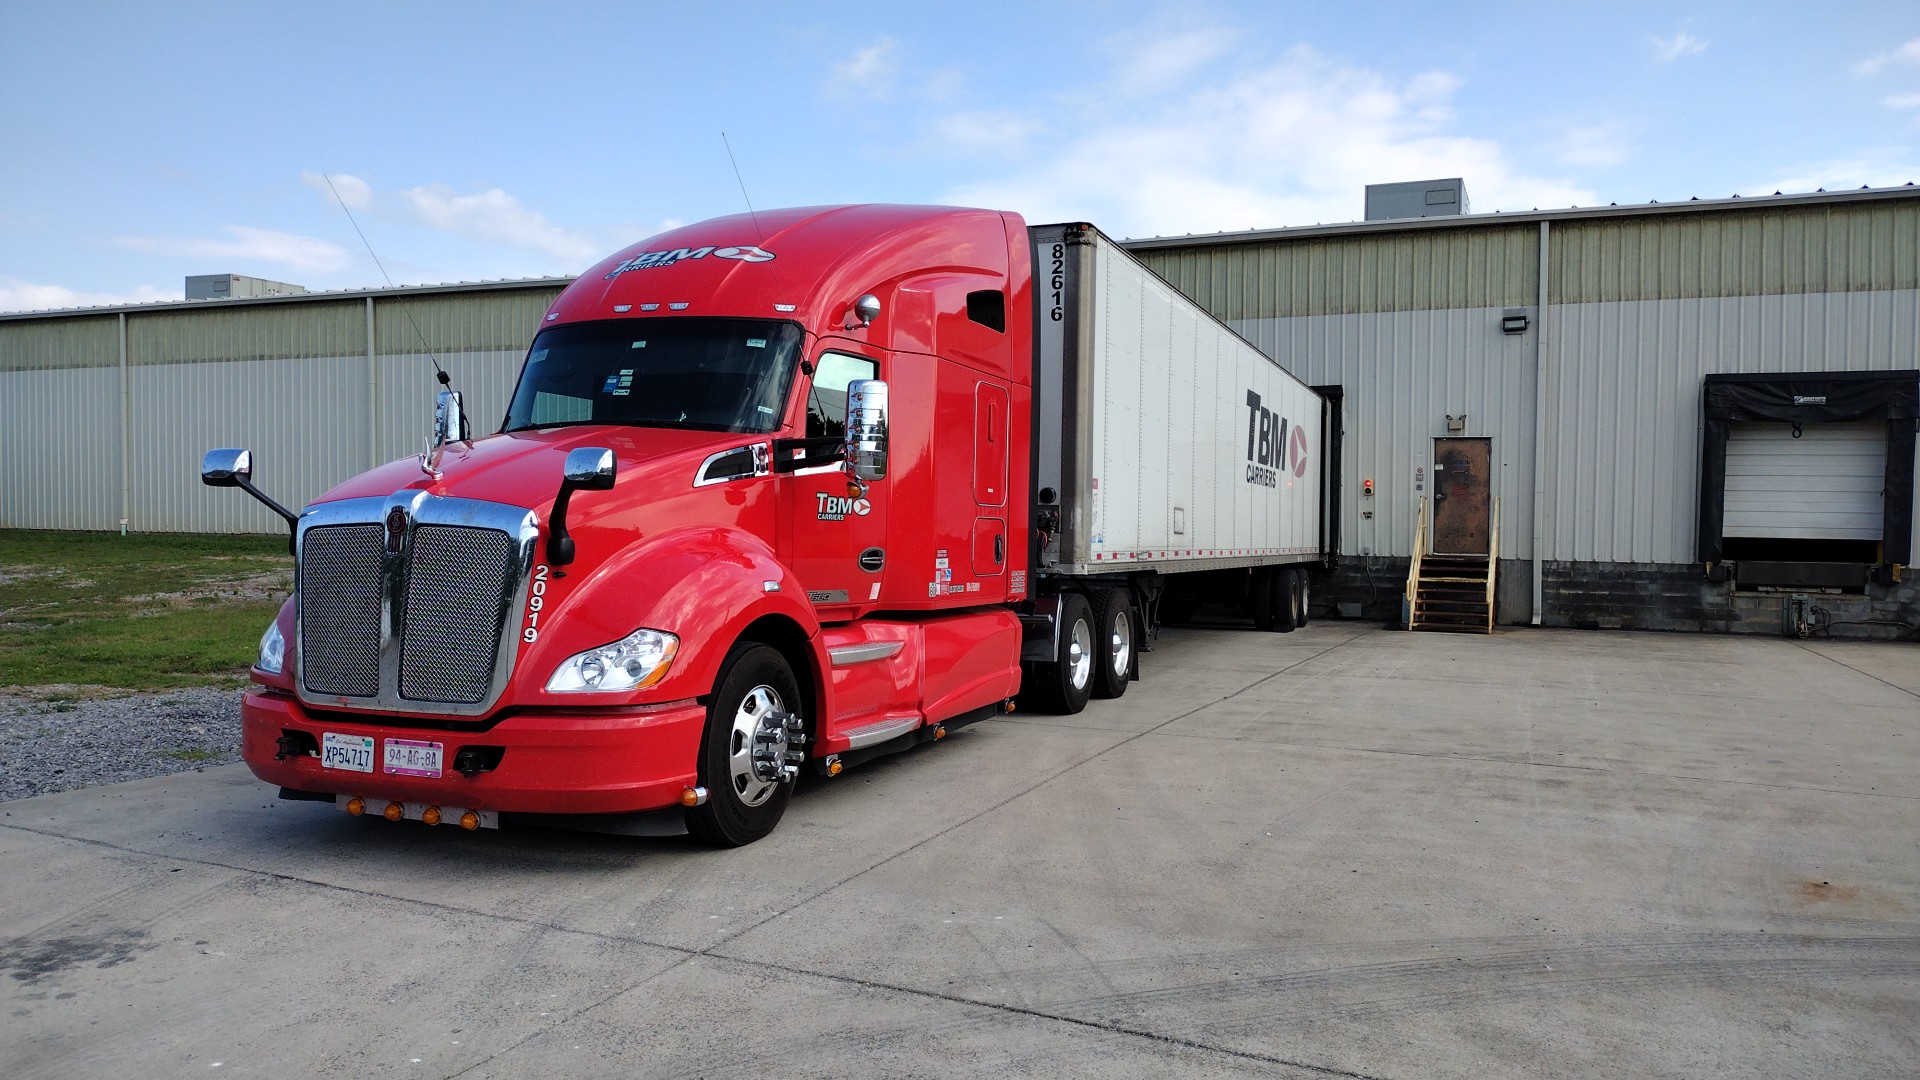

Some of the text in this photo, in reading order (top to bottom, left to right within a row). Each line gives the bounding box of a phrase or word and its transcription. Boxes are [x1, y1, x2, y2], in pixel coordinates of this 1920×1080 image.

[611, 246, 719, 275] TBM
[1051, 244, 1064, 322] 82616
[1246, 389, 1288, 471] TBM
[1246, 464, 1276, 488] CARRIERS
[816, 492, 853, 515] TBM
[817, 513, 845, 521] CARRIERS
[523, 565, 549, 643] 20919
[325, 746, 370, 767] XP54717
[389, 748, 437, 768] 94-AG-8A
